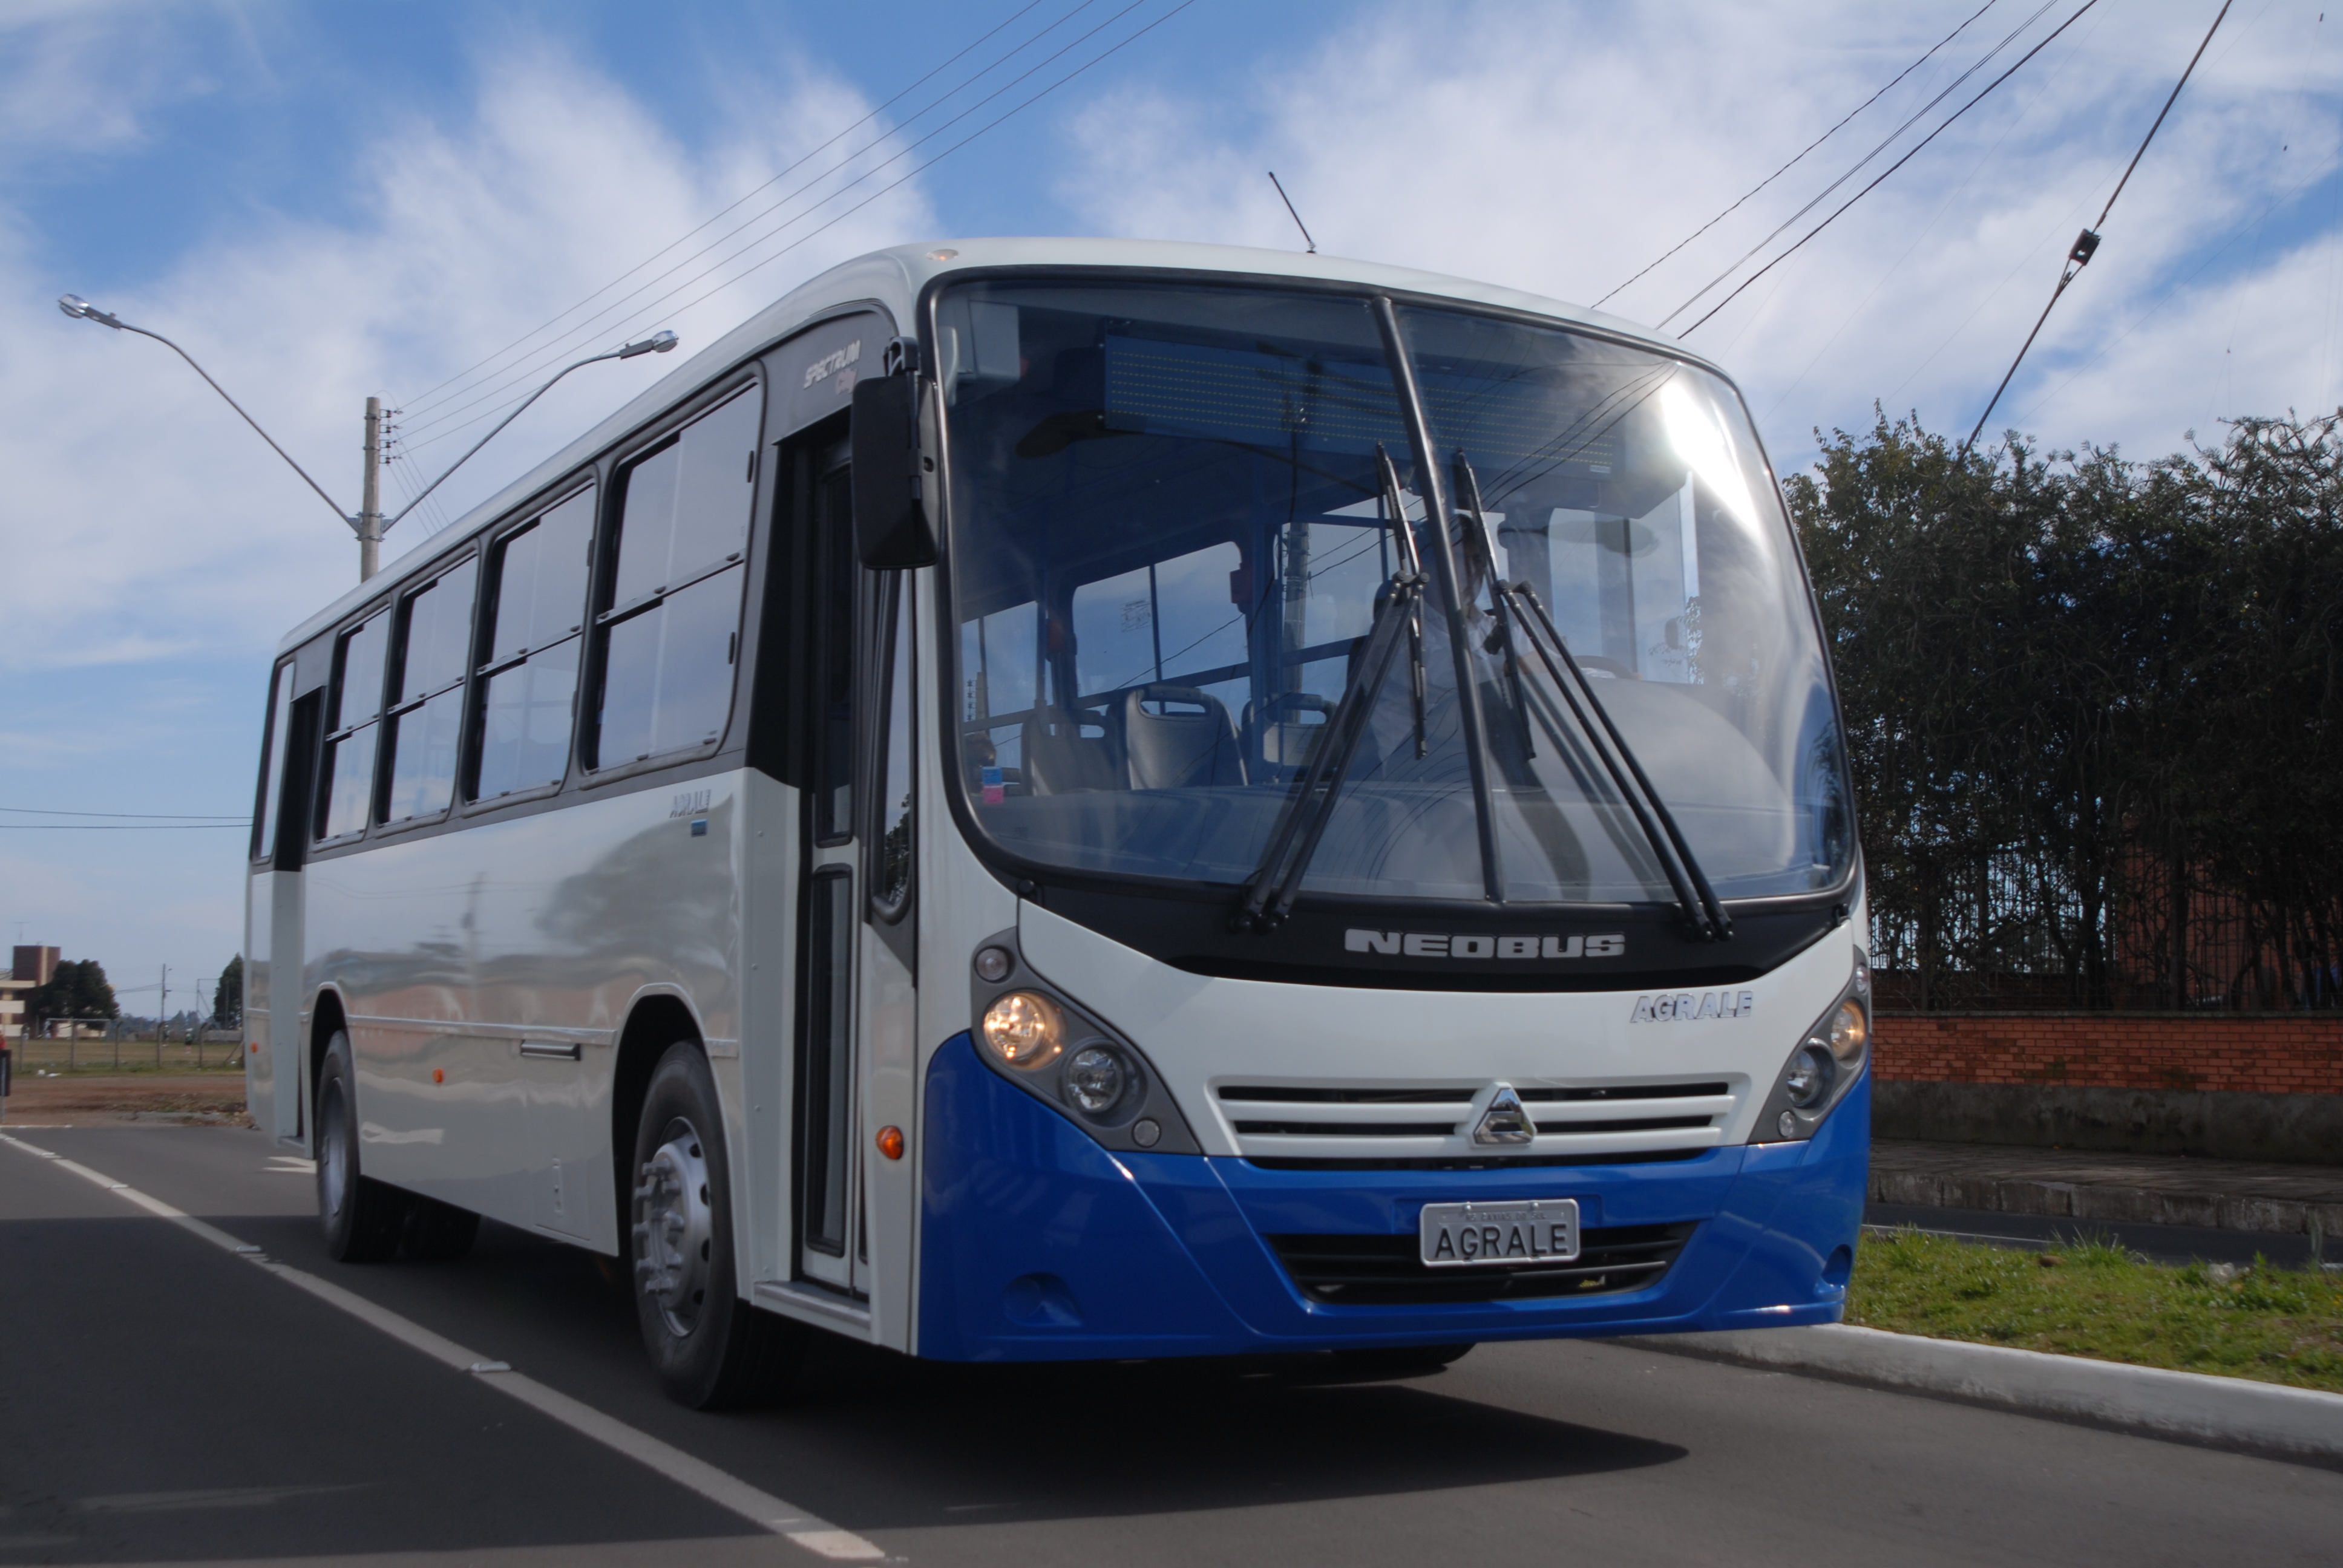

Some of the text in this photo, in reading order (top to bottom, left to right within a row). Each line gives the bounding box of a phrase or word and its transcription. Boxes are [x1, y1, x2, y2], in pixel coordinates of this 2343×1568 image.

[1345, 929, 1626, 959] NEOBUS
[1630, 990, 1753, 1023] AGRALE
[1434, 1223, 1567, 1258] AGRALE
